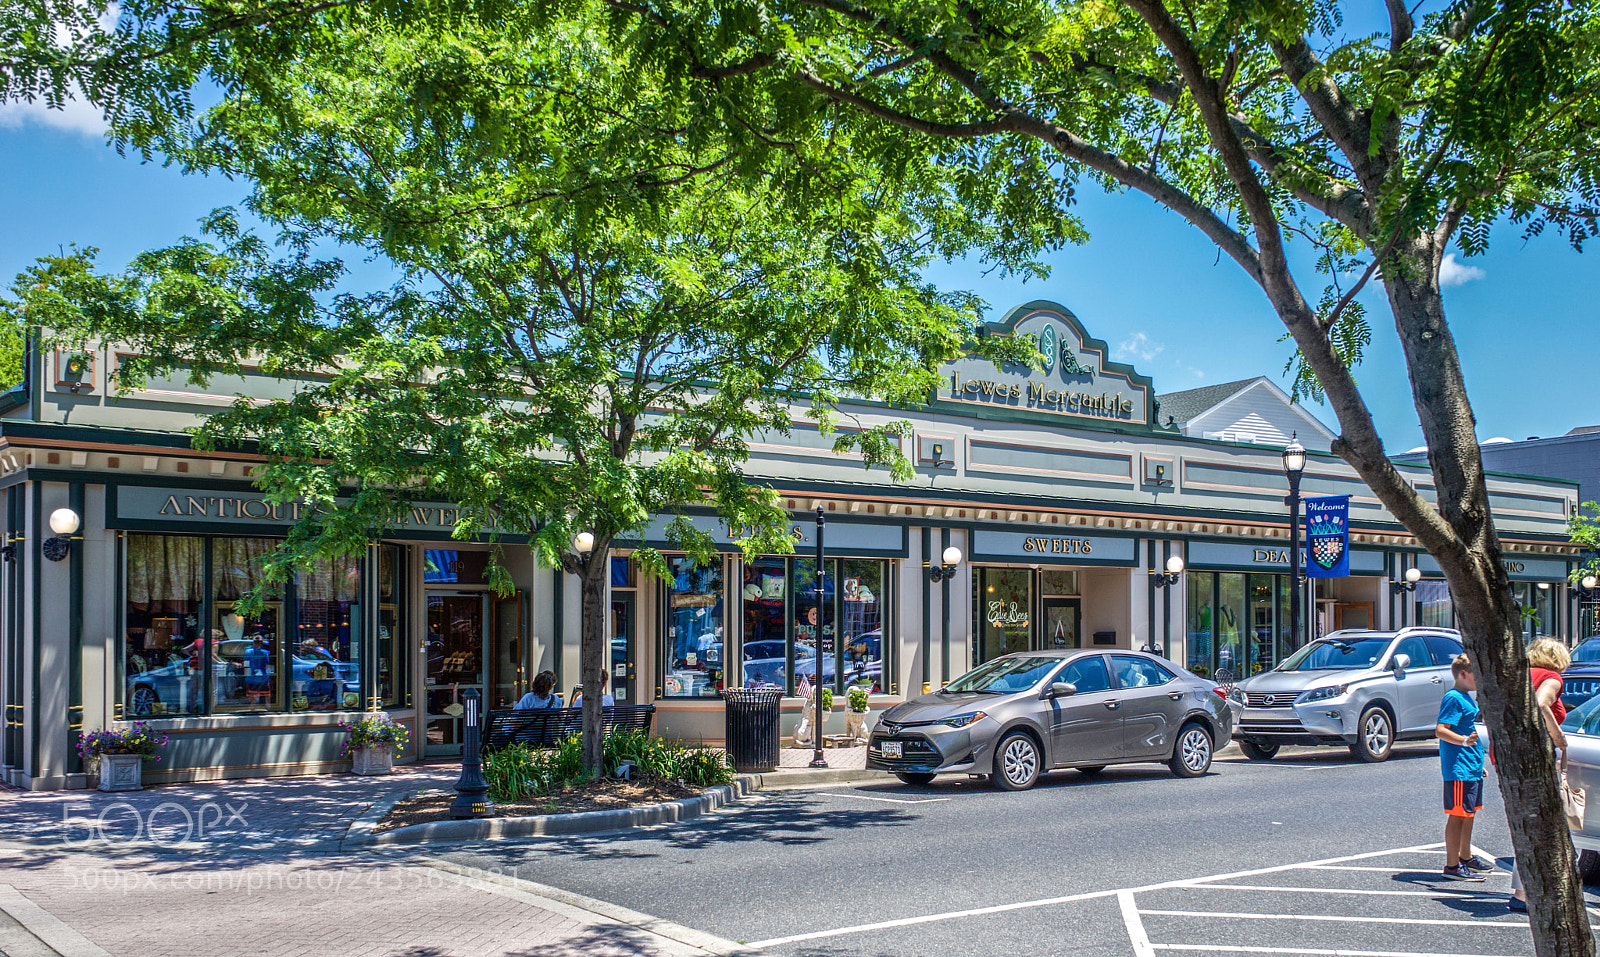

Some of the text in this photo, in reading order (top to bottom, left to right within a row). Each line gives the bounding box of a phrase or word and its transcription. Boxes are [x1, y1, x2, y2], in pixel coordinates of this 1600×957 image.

[952, 370, 1135, 414] Lewes Mercantile
[160, 495, 503, 529] ANTIQUE EWELY
[1308, 502, 1345, 511] Welcome
[1023, 537, 1093, 554] SWEETS
